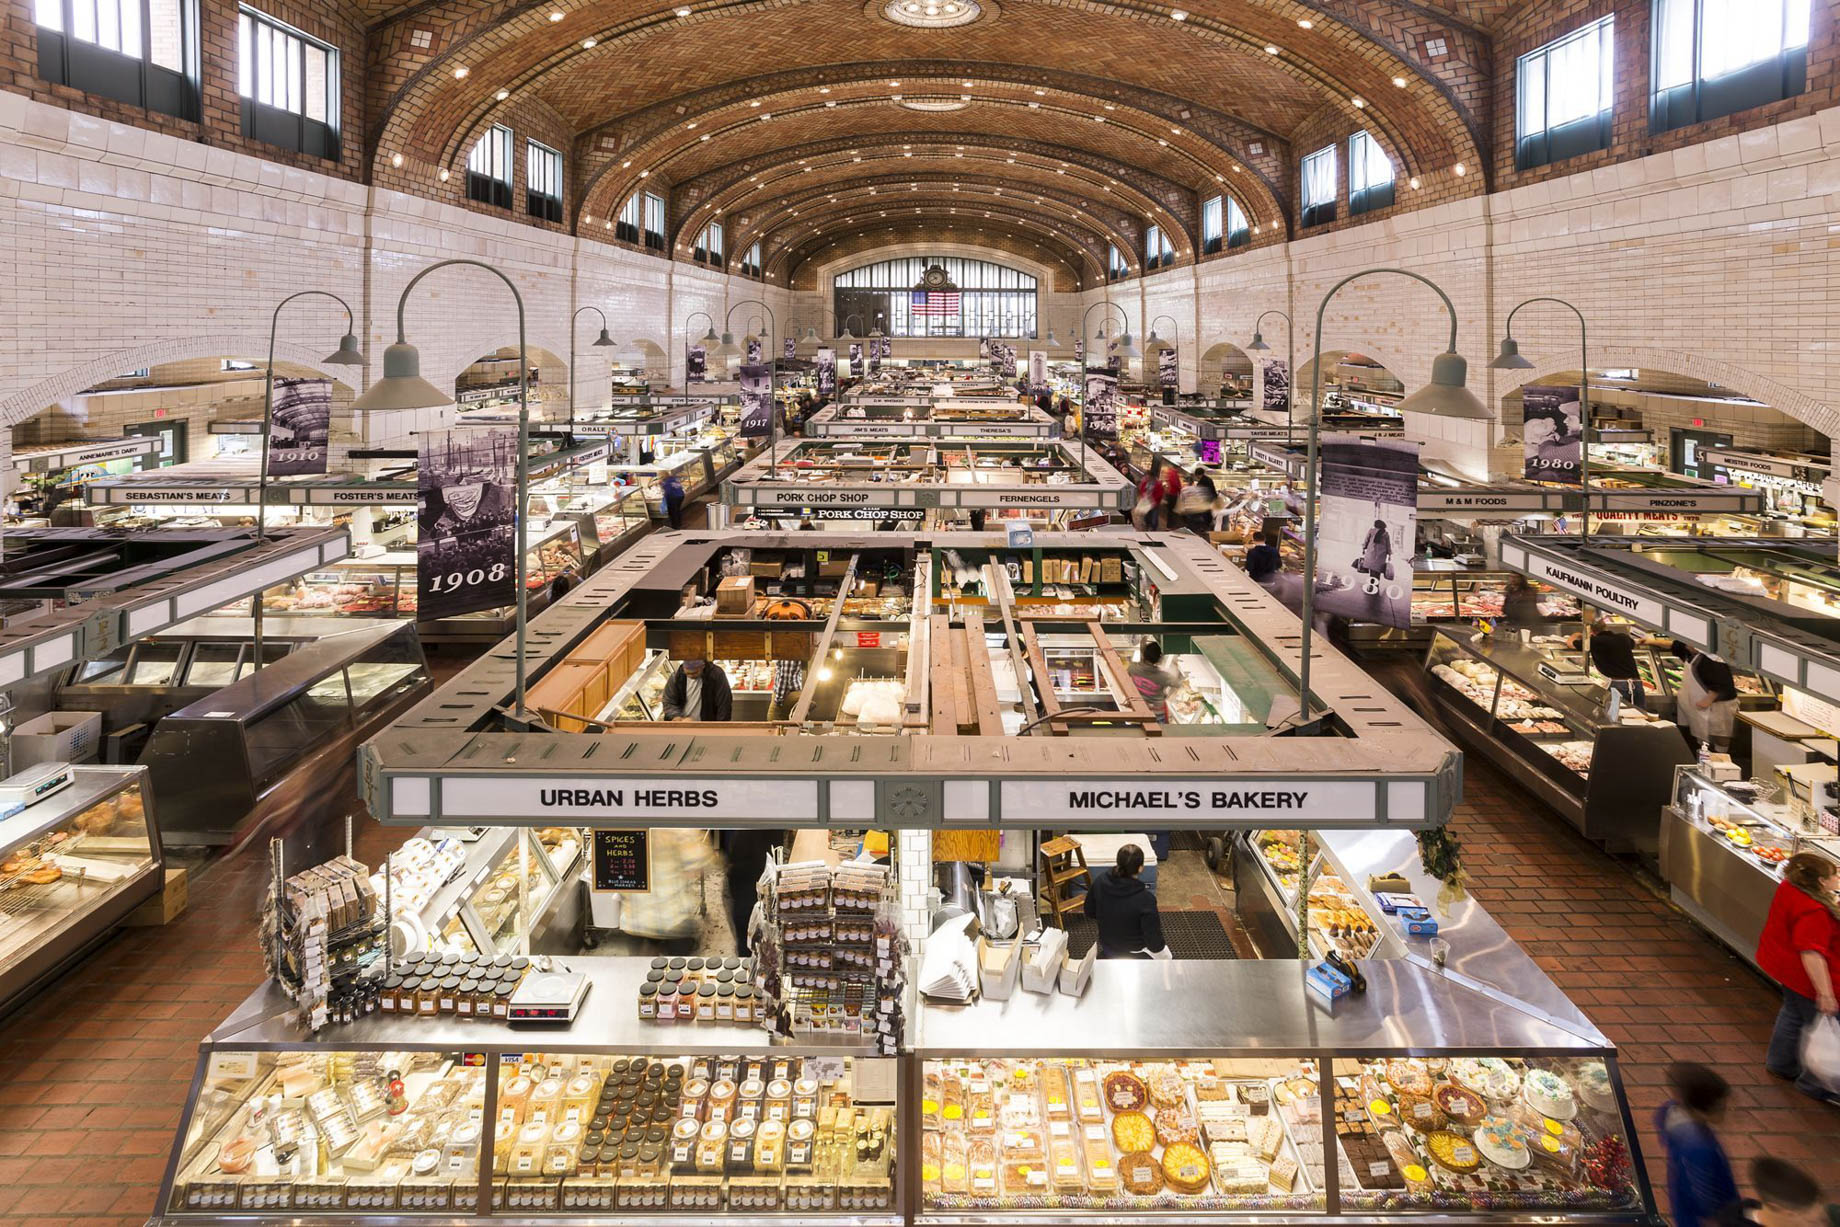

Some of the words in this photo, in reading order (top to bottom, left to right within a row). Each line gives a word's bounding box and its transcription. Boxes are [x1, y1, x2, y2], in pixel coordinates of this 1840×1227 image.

[745, 418, 768, 429] 1917
[78, 449, 121, 461] ANNEMARIE'S
[276, 451, 319, 463] 1910
[1531, 458, 1574, 470] 1980
[1749, 462, 1772, 471] FOODS
[125, 492, 194, 500] SEBASTIAN'S
[195, 492, 231, 500] MEATS
[333, 492, 384, 501] FOSTER'S
[776, 493, 805, 503] PORK
[807, 493, 837, 503] CHOP
[839, 493, 869, 503] SHOP
[999, 495, 1061, 503] FERNENGELS
[1649, 499, 1697, 507] PINZONE'S
[818, 509, 853, 519] PORK
[854, 509, 889, 519] CHOP
[890, 509, 924, 520] SHOP
[1596, 512, 1640, 520] QUALITY
[1643, 512, 1679, 521] MEATS
[428, 562, 505, 594] 1908
[1321, 570, 1404, 600] 1980
[1545, 565, 1593, 592] KAUFMANN
[1595, 585, 1639, 610] POULTRY
[540, 789, 623, 807] URBAN
[634, 790, 718, 808] HERBS
[1069, 791, 1201, 809] MICHAEL'S
[1211, 791, 1308, 809] BAKERY
[605, 835, 635, 844] SPICES
[606, 849, 634, 857] HERBS
